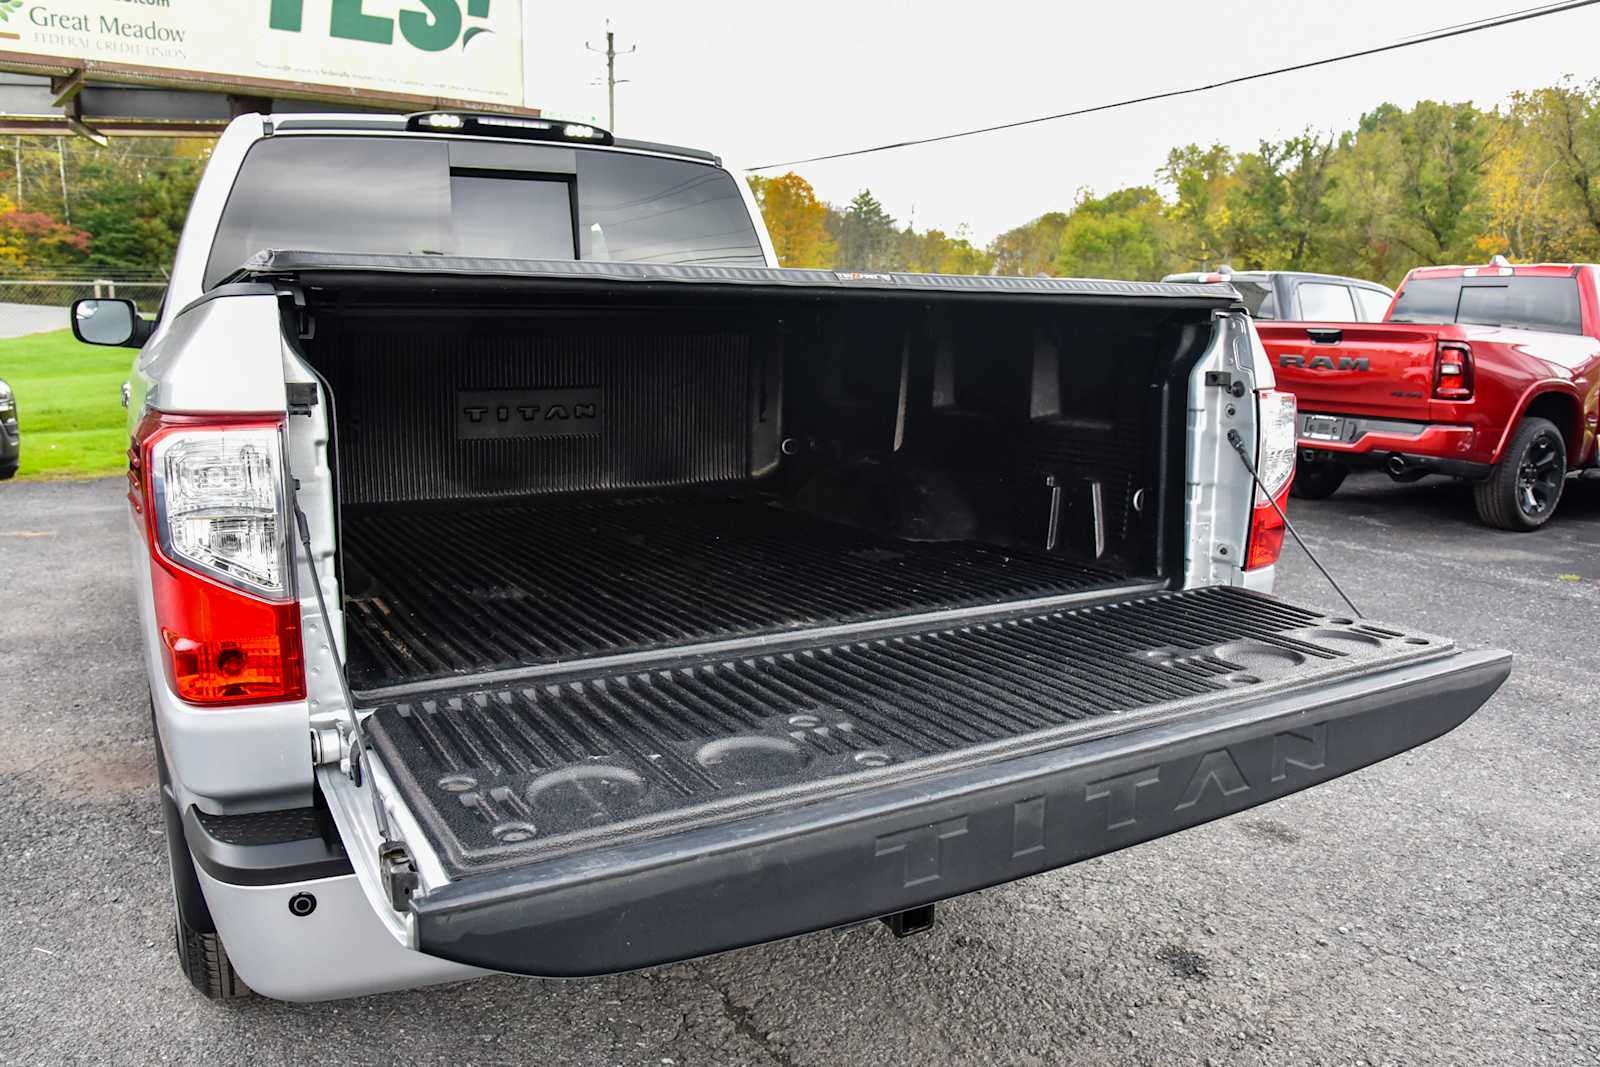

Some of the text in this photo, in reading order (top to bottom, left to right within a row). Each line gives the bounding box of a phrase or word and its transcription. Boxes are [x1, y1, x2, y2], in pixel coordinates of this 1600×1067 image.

[29, 6, 186, 43] Great Meadow
[33, 31, 187, 59] FEDERAL CREDIT UNION
[1279, 354, 1370, 371] RAM
[463, 403, 596, 423] TITAN
[874, 721, 1329, 888] TITAN
